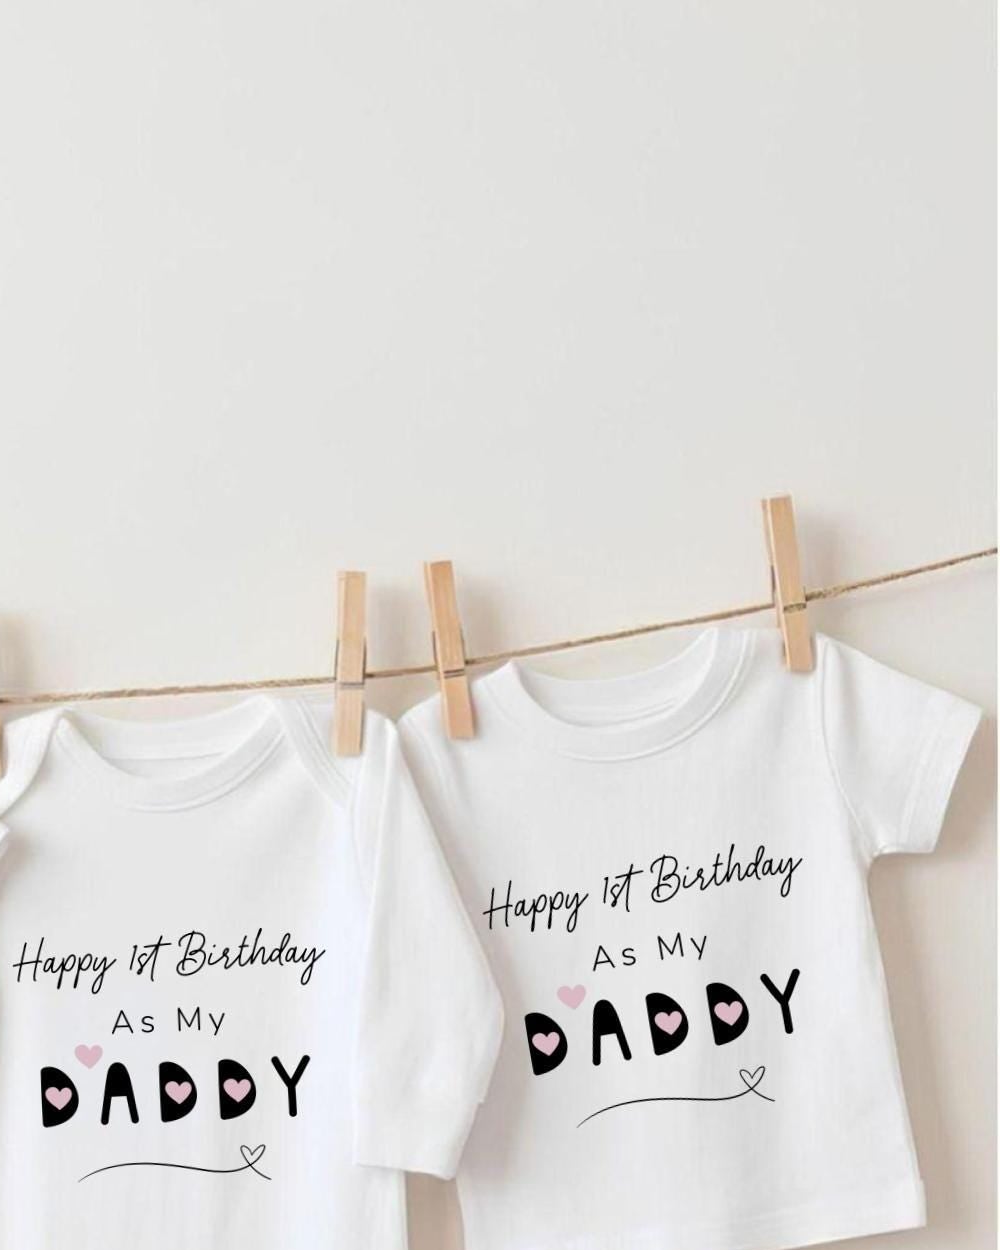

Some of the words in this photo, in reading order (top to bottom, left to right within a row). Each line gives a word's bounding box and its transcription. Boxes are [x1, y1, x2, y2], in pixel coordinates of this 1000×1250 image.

[482, 879, 589, 934] Happy
[602, 863, 644, 913] 1st
[649, 843, 803, 904] Birthday
[12, 936, 117, 995] Happy
[129, 935, 172, 982] 1st
[175, 927, 326, 986] Birthday
[592, 945, 637, 972] As
[657, 932, 708, 961] My
[111, 1009, 155, 1035] As
[177, 1006, 225, 1036] My
[523, 968, 801, 1077] DADDY
[40, 1054, 311, 1128] DADDY
